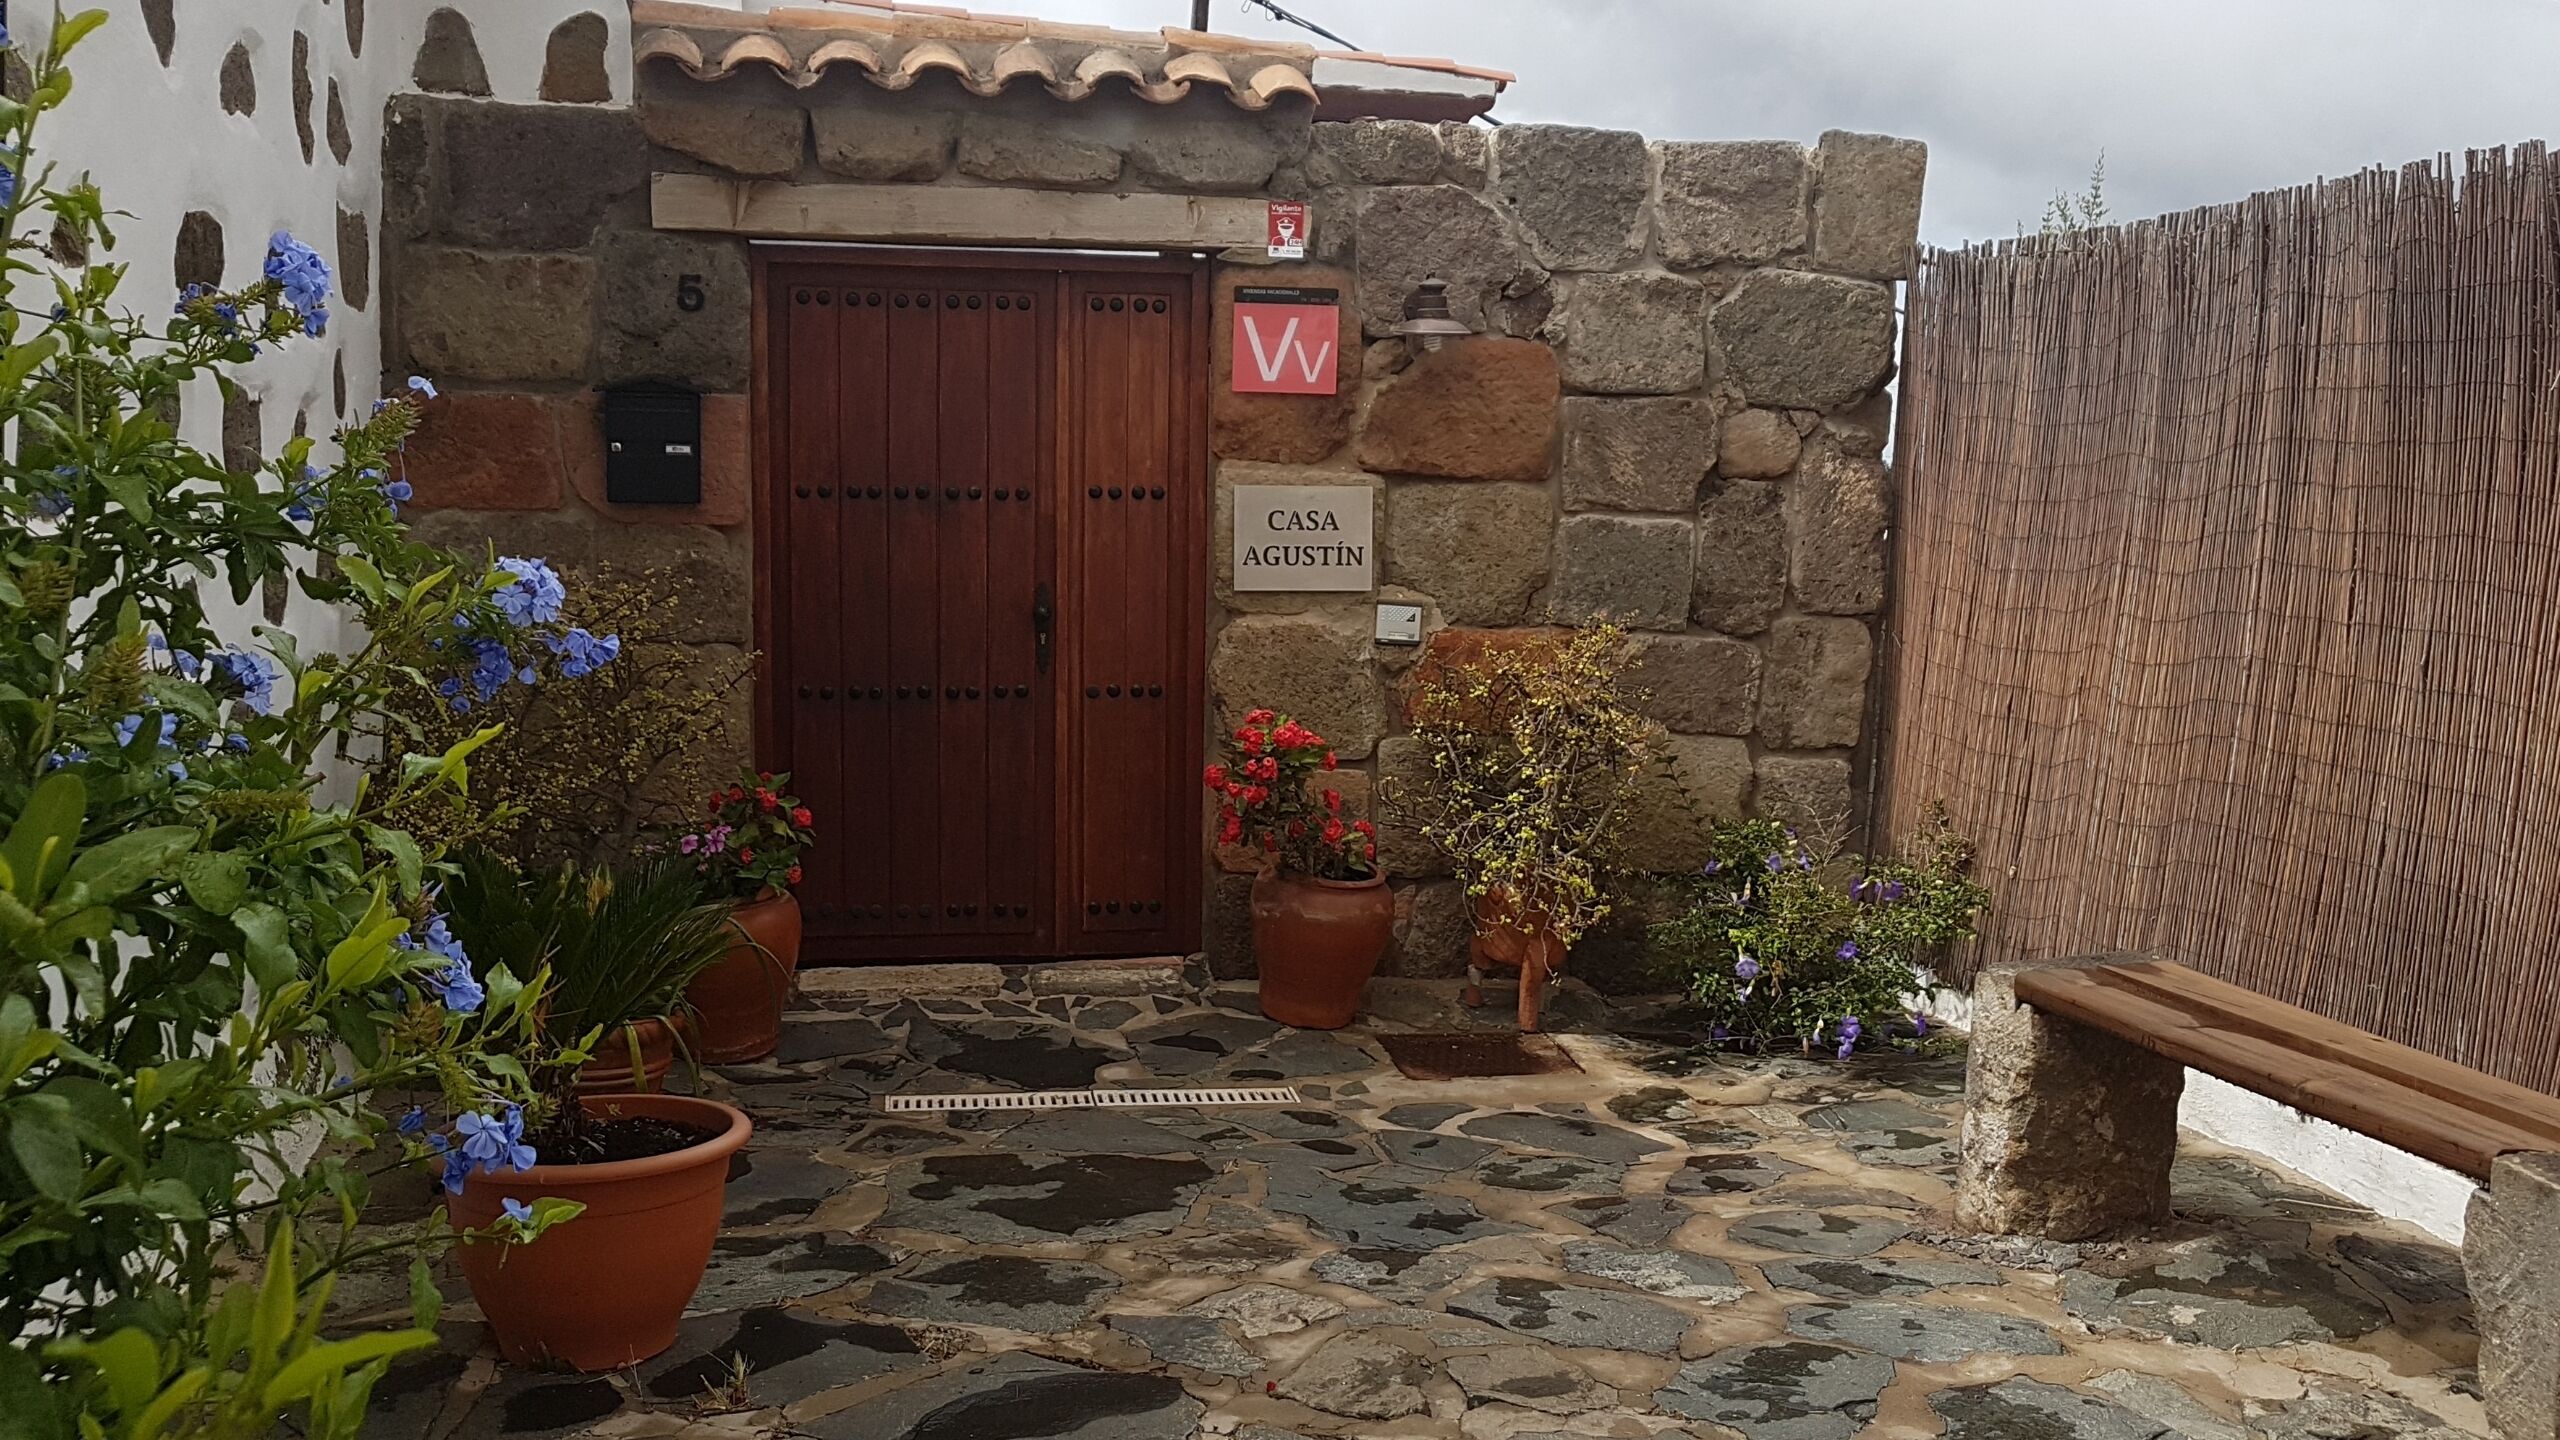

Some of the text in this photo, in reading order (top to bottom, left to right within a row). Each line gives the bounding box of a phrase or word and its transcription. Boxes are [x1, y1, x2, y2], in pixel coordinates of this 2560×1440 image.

[1271, 204, 1302, 212] Vigilante
[676, 273, 704, 312] 5
[1267, 510, 1340, 531] CASA
[1242, 541, 1364, 566] AGUSTÍN
